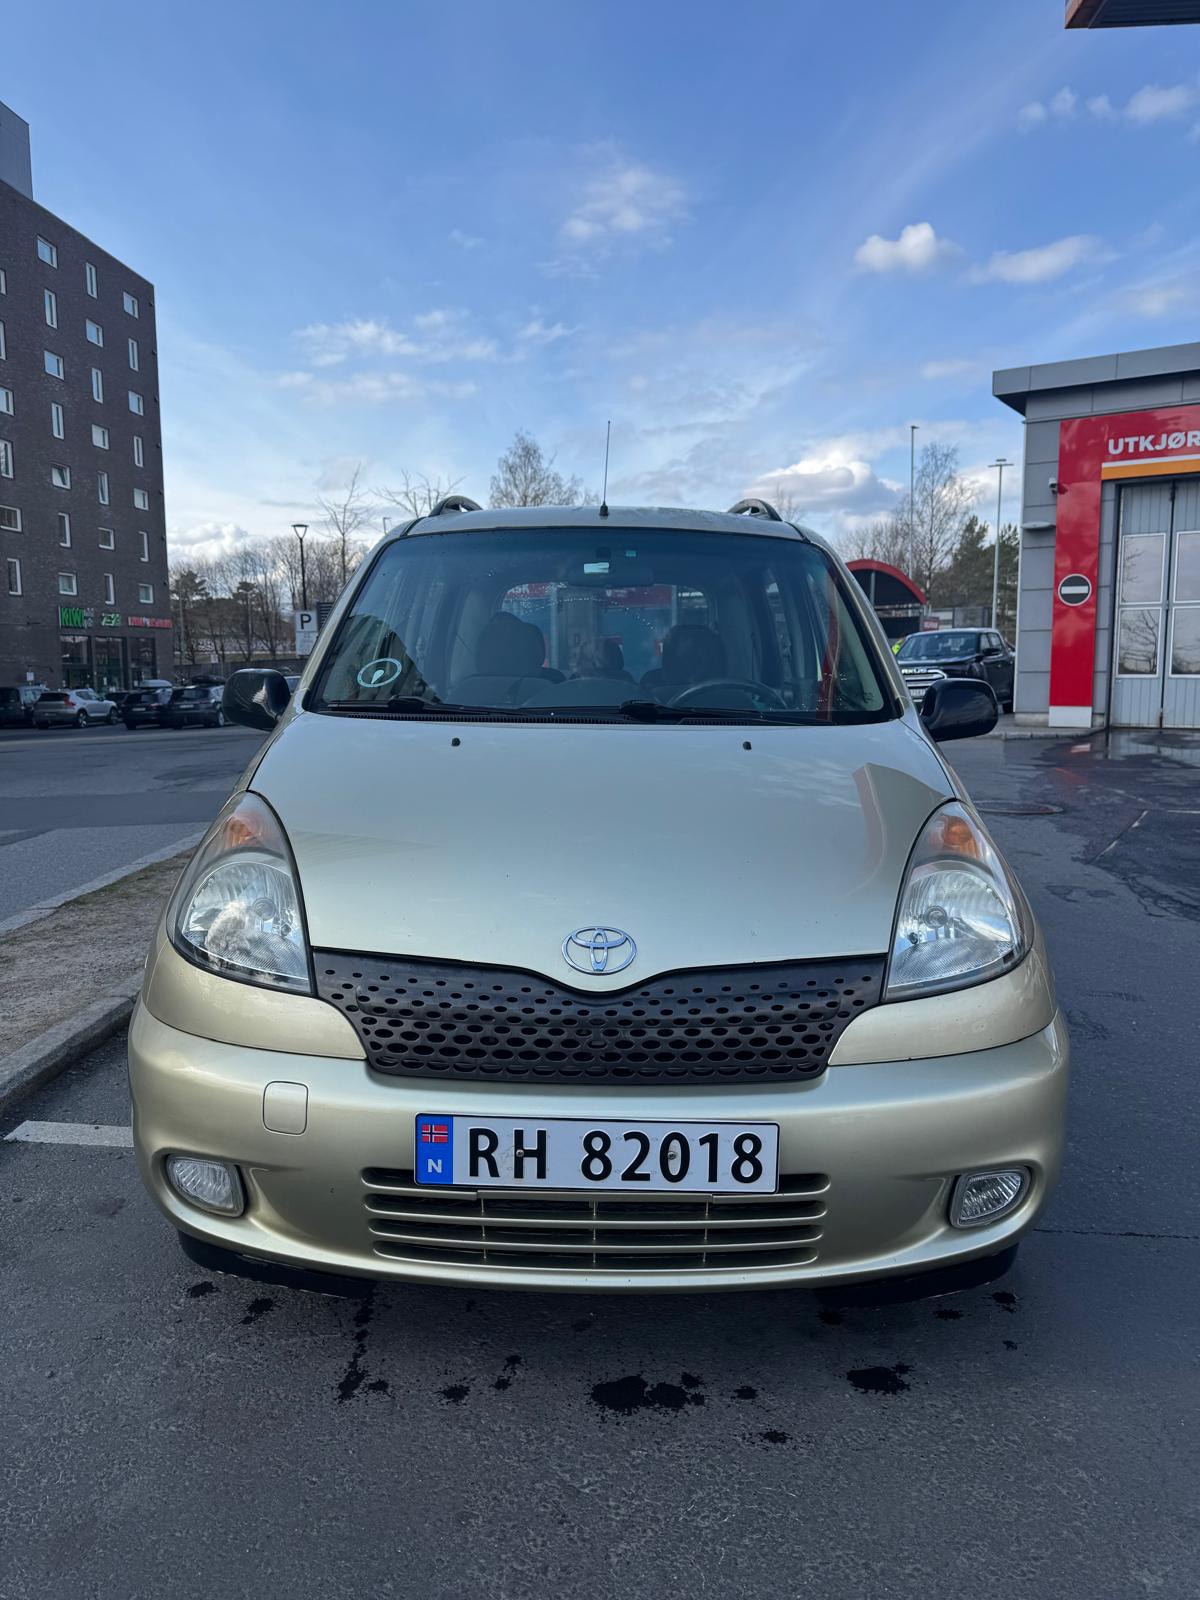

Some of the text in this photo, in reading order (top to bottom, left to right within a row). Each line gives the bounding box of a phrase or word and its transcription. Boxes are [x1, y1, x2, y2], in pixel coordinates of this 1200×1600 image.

[1108, 431, 1200, 455] UTKJØR
[300, 613, 312, 630] P
[468, 1127, 763, 1184] RH 82018
[427, 1159, 443, 1174] N
